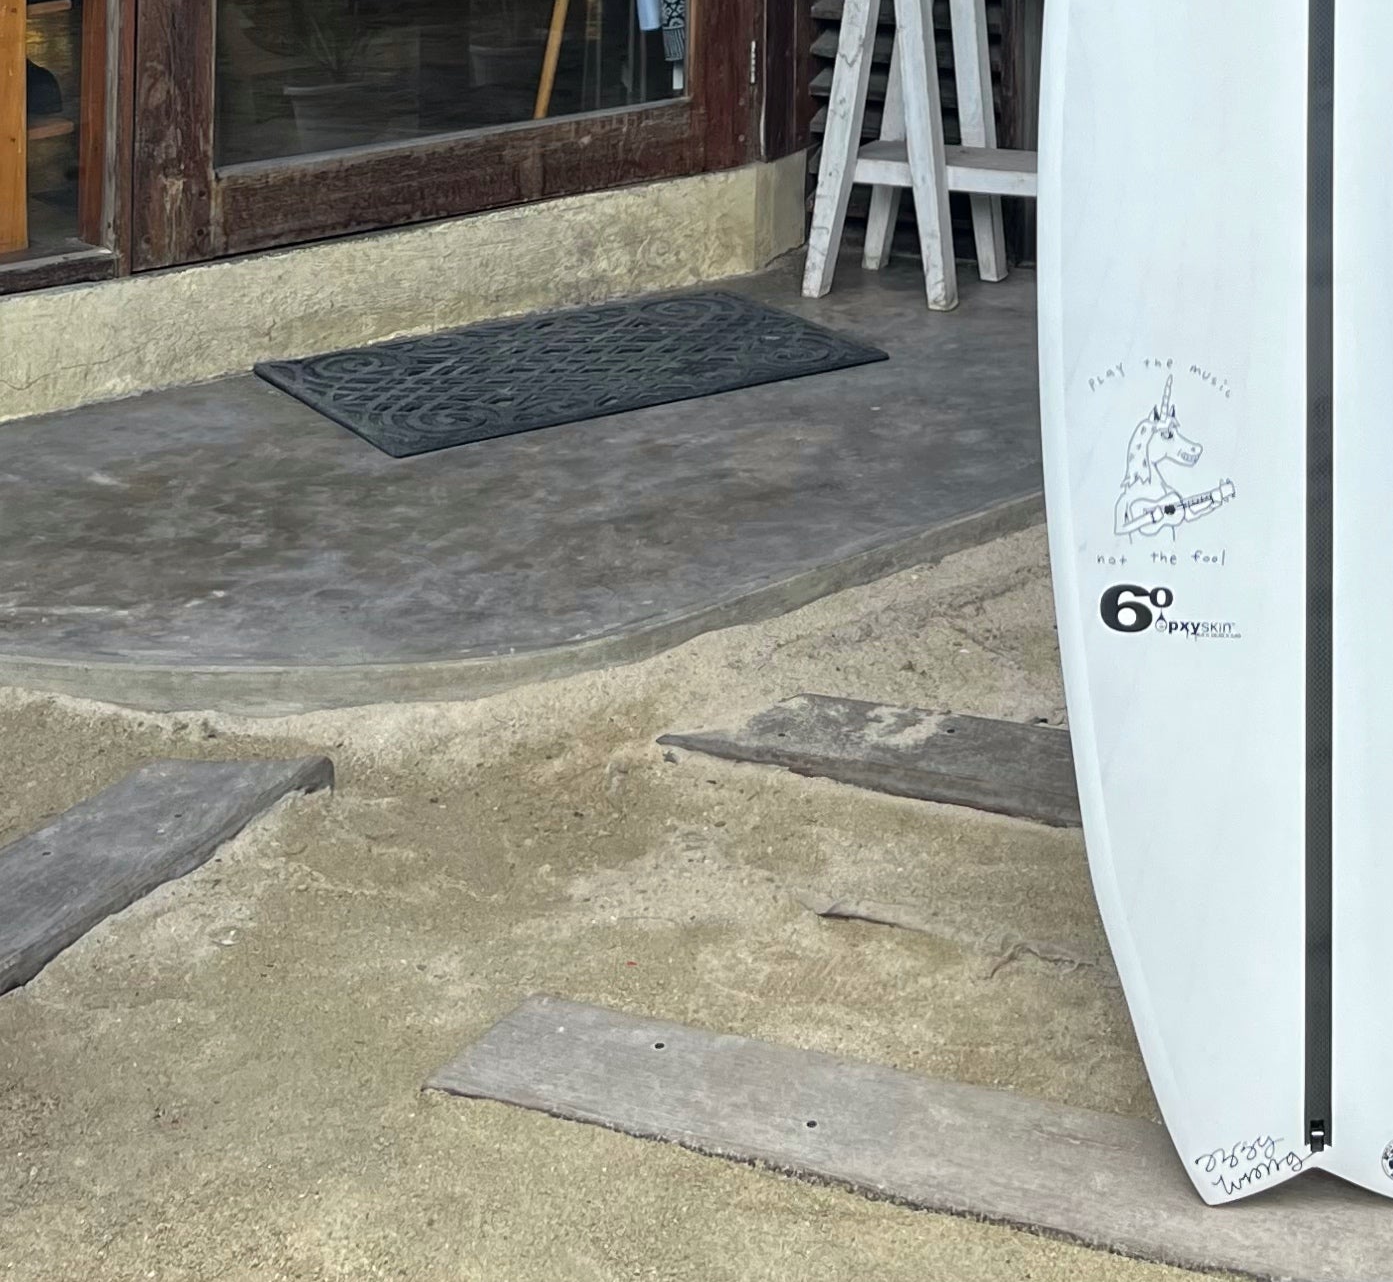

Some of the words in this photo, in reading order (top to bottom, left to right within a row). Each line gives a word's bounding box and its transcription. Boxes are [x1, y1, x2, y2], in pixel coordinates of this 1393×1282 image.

[1144, 358, 1174, 368] the
[1189, 364, 1231, 399] music
[1097, 553, 1128, 566] not
[1150, 551, 1177, 566] the
[1190, 549, 1226, 566] fool
